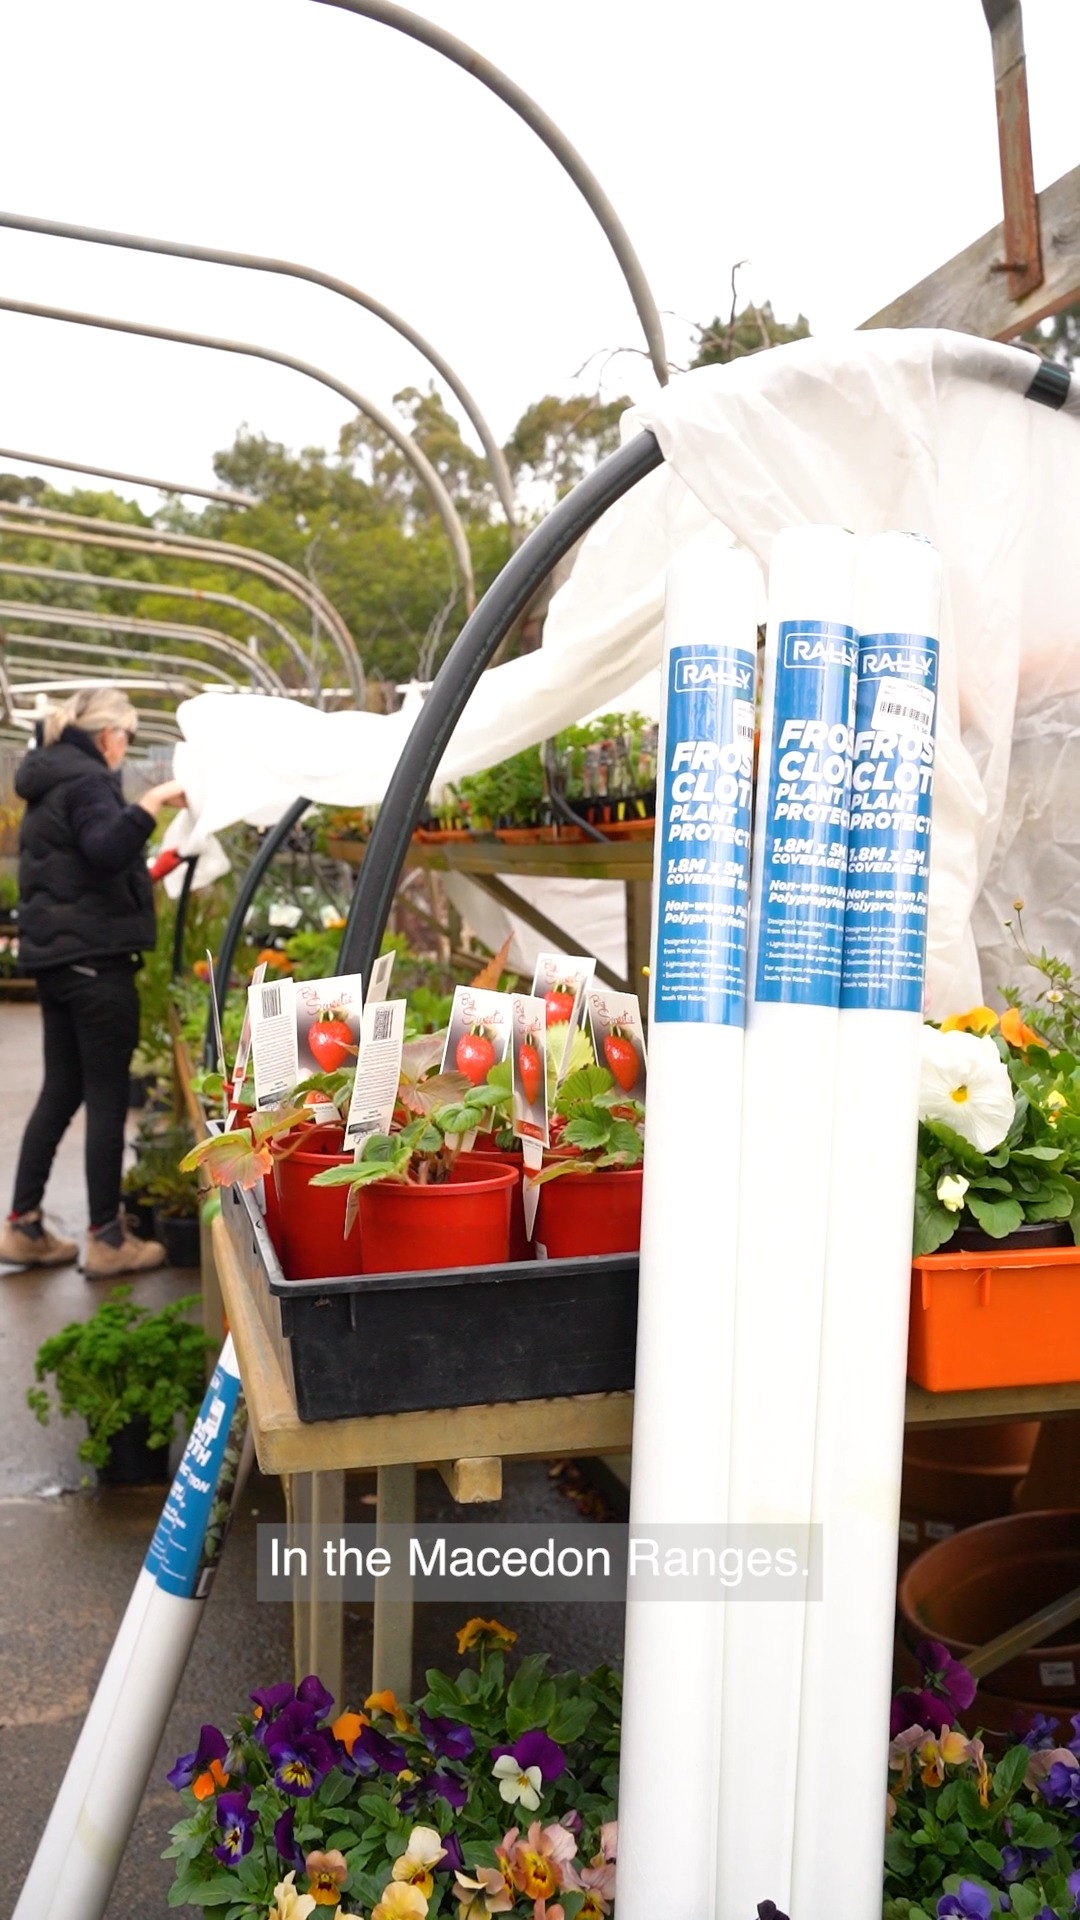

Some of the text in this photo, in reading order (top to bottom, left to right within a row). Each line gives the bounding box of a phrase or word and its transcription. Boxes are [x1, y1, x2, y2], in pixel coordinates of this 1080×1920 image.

[793, 640, 858, 668] RALLY
[862, 652, 933, 676] RALLY
[683, 664, 751, 690] RALLY
[775, 782, 844, 805] PLANT
[851, 792, 919, 811] PLANT
[669, 803, 738, 824] PLANT
[774, 802, 850, 828] PROTEC
[773, 838, 814, 854] 1.8M
[772, 853, 840, 870] COVERAGE
[849, 847, 887, 862] 1.8M
[903, 848, 925, 864] 5M
[668, 858, 706, 873] 1.8M
[723, 861, 744, 878] 5M
[848, 862, 918, 876] COVERAGE
[666, 873, 736, 888] COVERAGE
[769, 880, 839, 895] Non-woven
[846, 888, 916, 901] Non-woven
[665, 900, 735, 914] Non-woven
